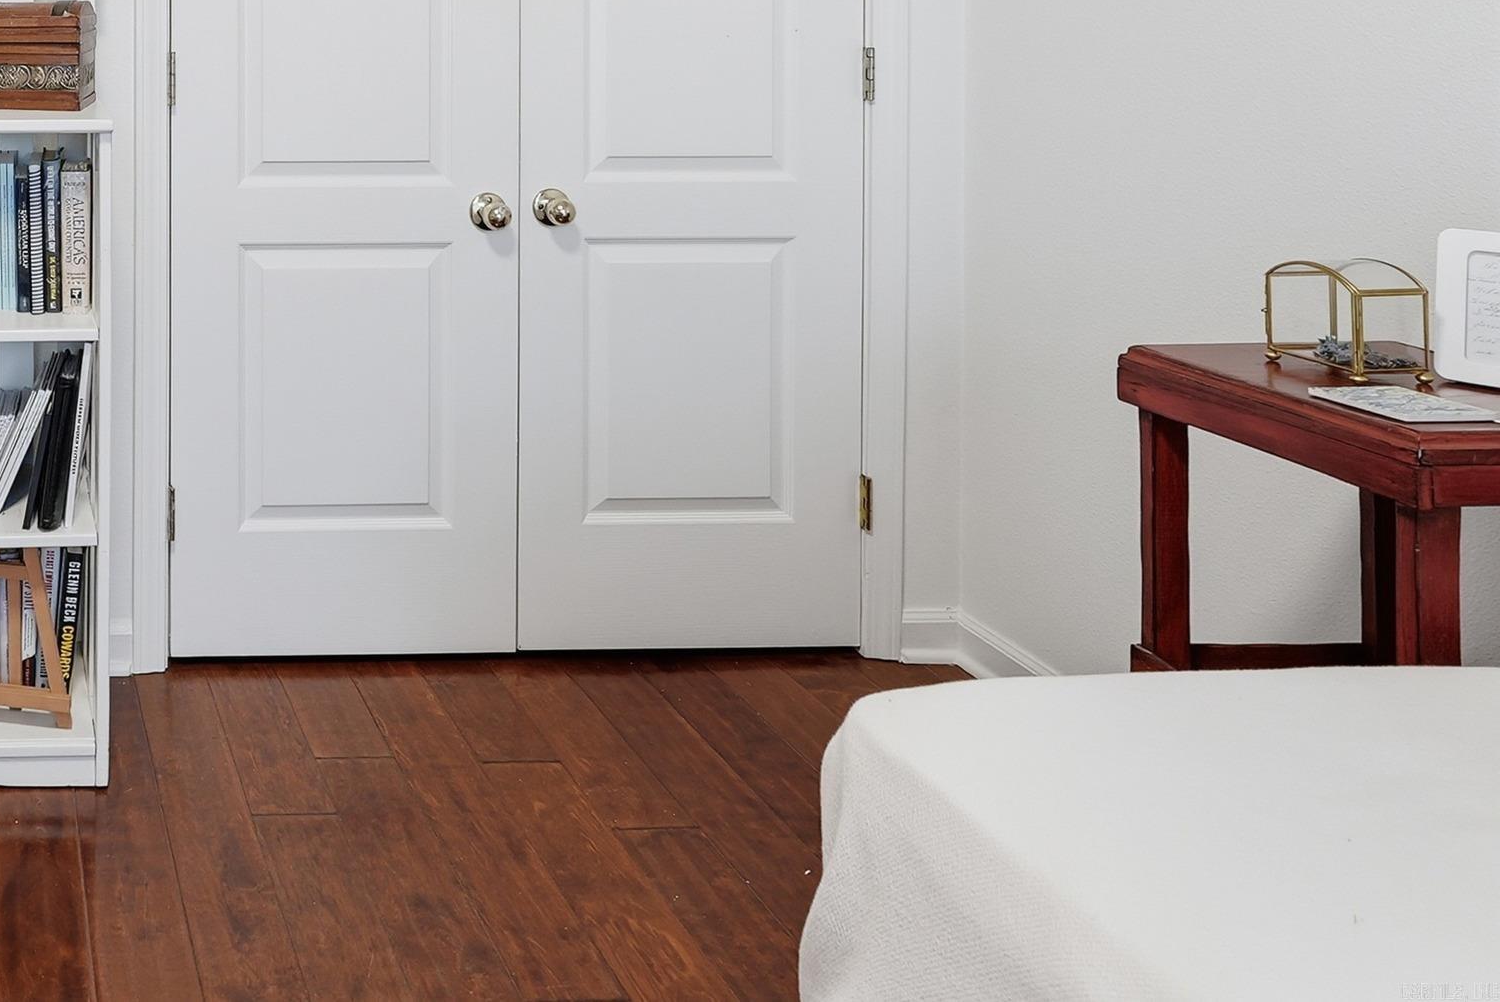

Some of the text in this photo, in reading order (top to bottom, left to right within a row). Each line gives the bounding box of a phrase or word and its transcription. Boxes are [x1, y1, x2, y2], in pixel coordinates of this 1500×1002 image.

[73, 197, 86, 266] AMERICA'S
[45, 550, 55, 569] SECRET
[23, 591, 35, 611] STATE
[60, 561, 81, 680] GLENN BECK COWARDS
